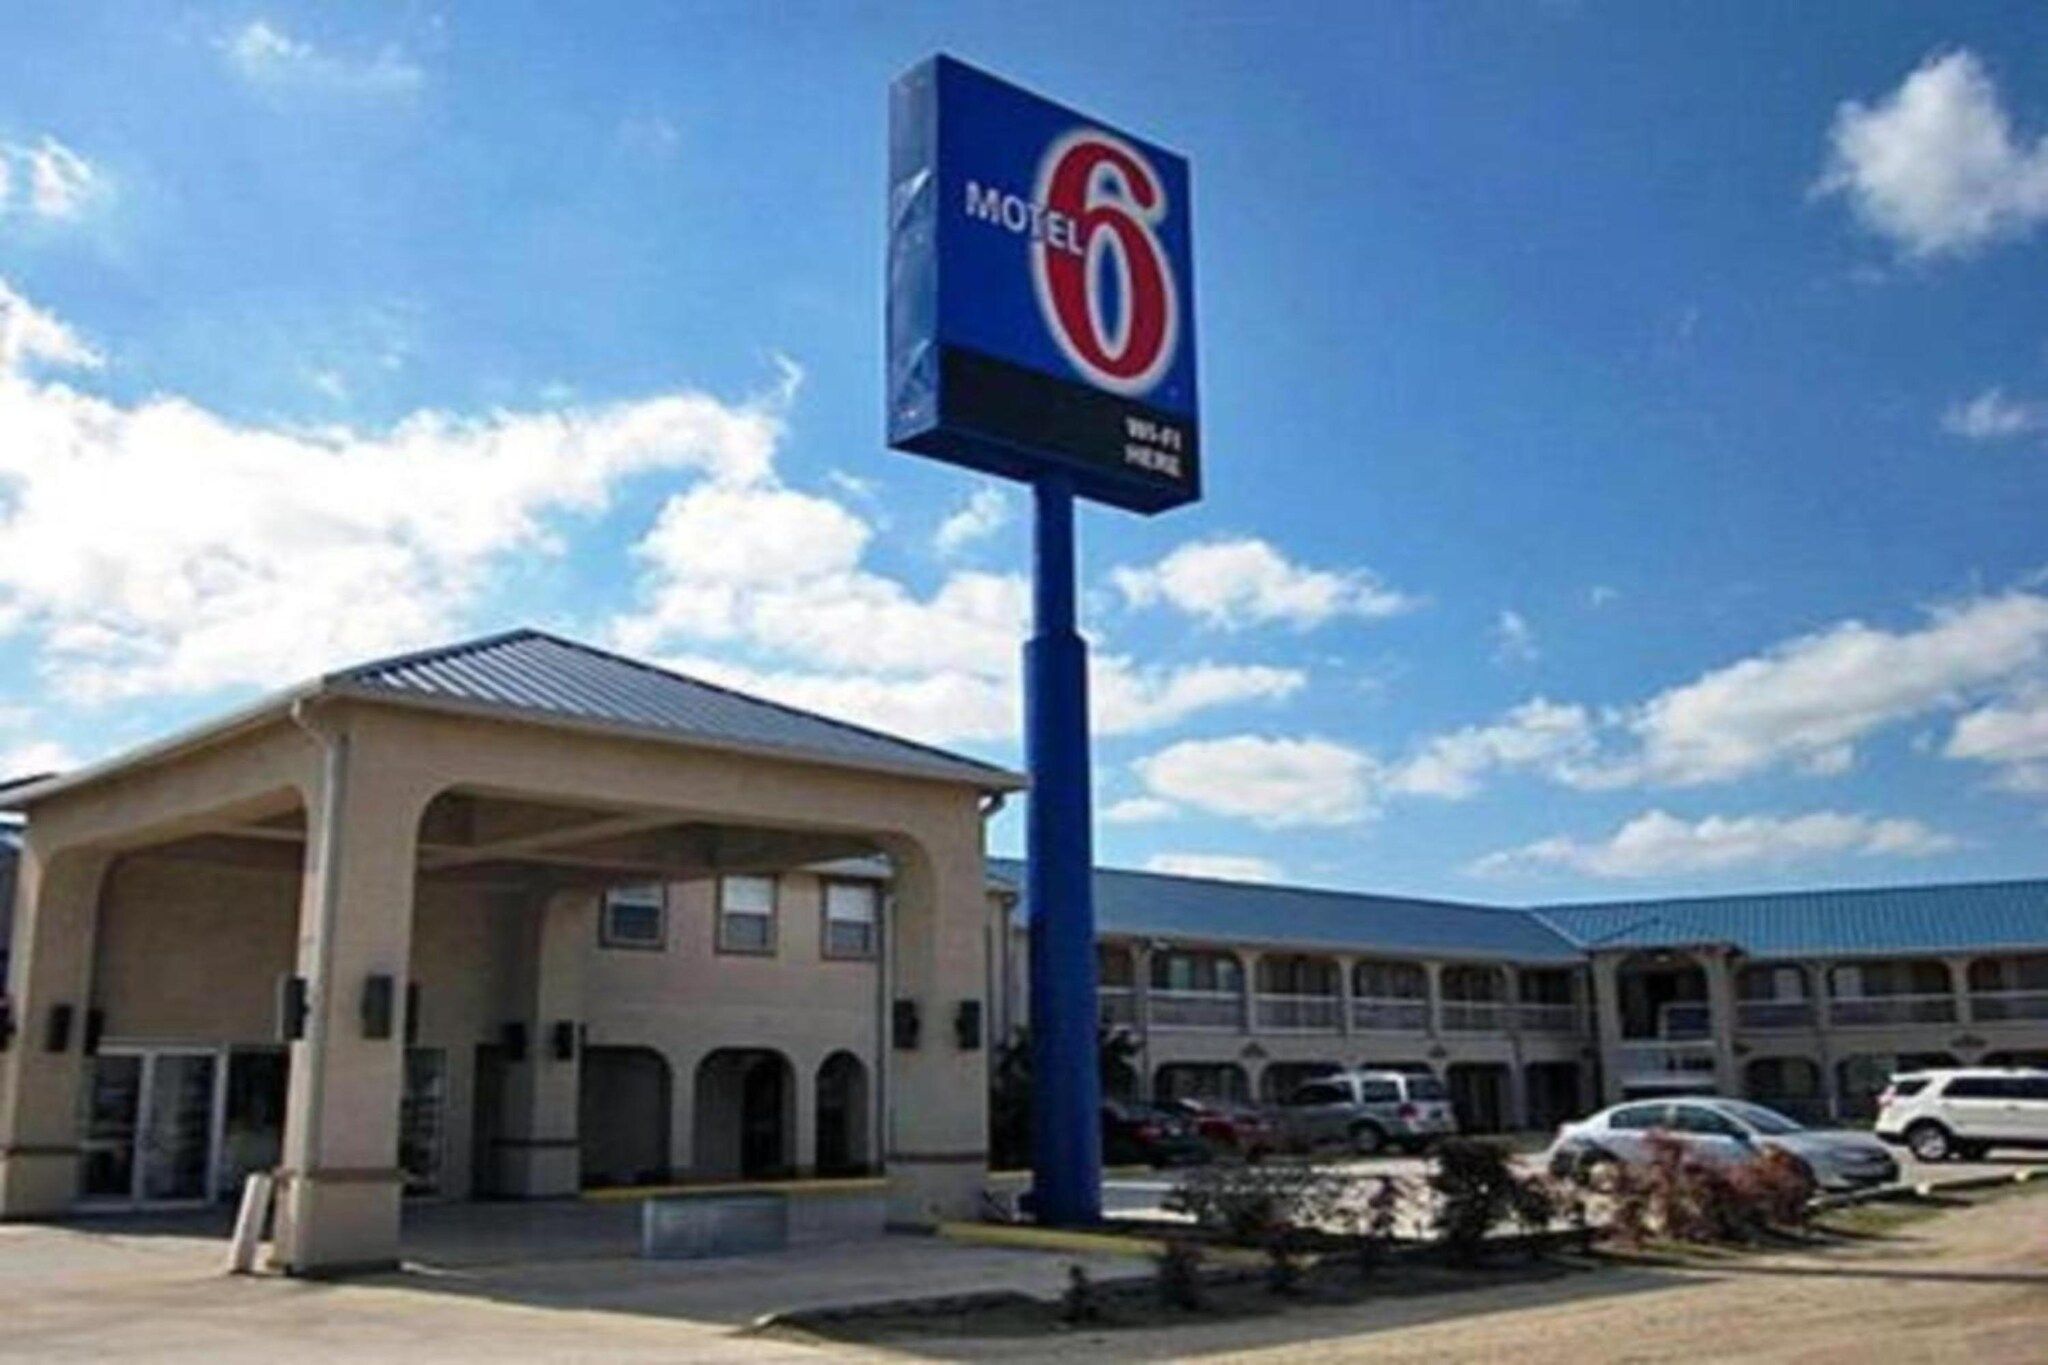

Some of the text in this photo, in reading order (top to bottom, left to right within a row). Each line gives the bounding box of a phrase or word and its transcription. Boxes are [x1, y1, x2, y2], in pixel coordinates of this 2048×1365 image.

[965, 129, 1174, 395] MOTEL 6
[1124, 443, 1182, 478] HERE
